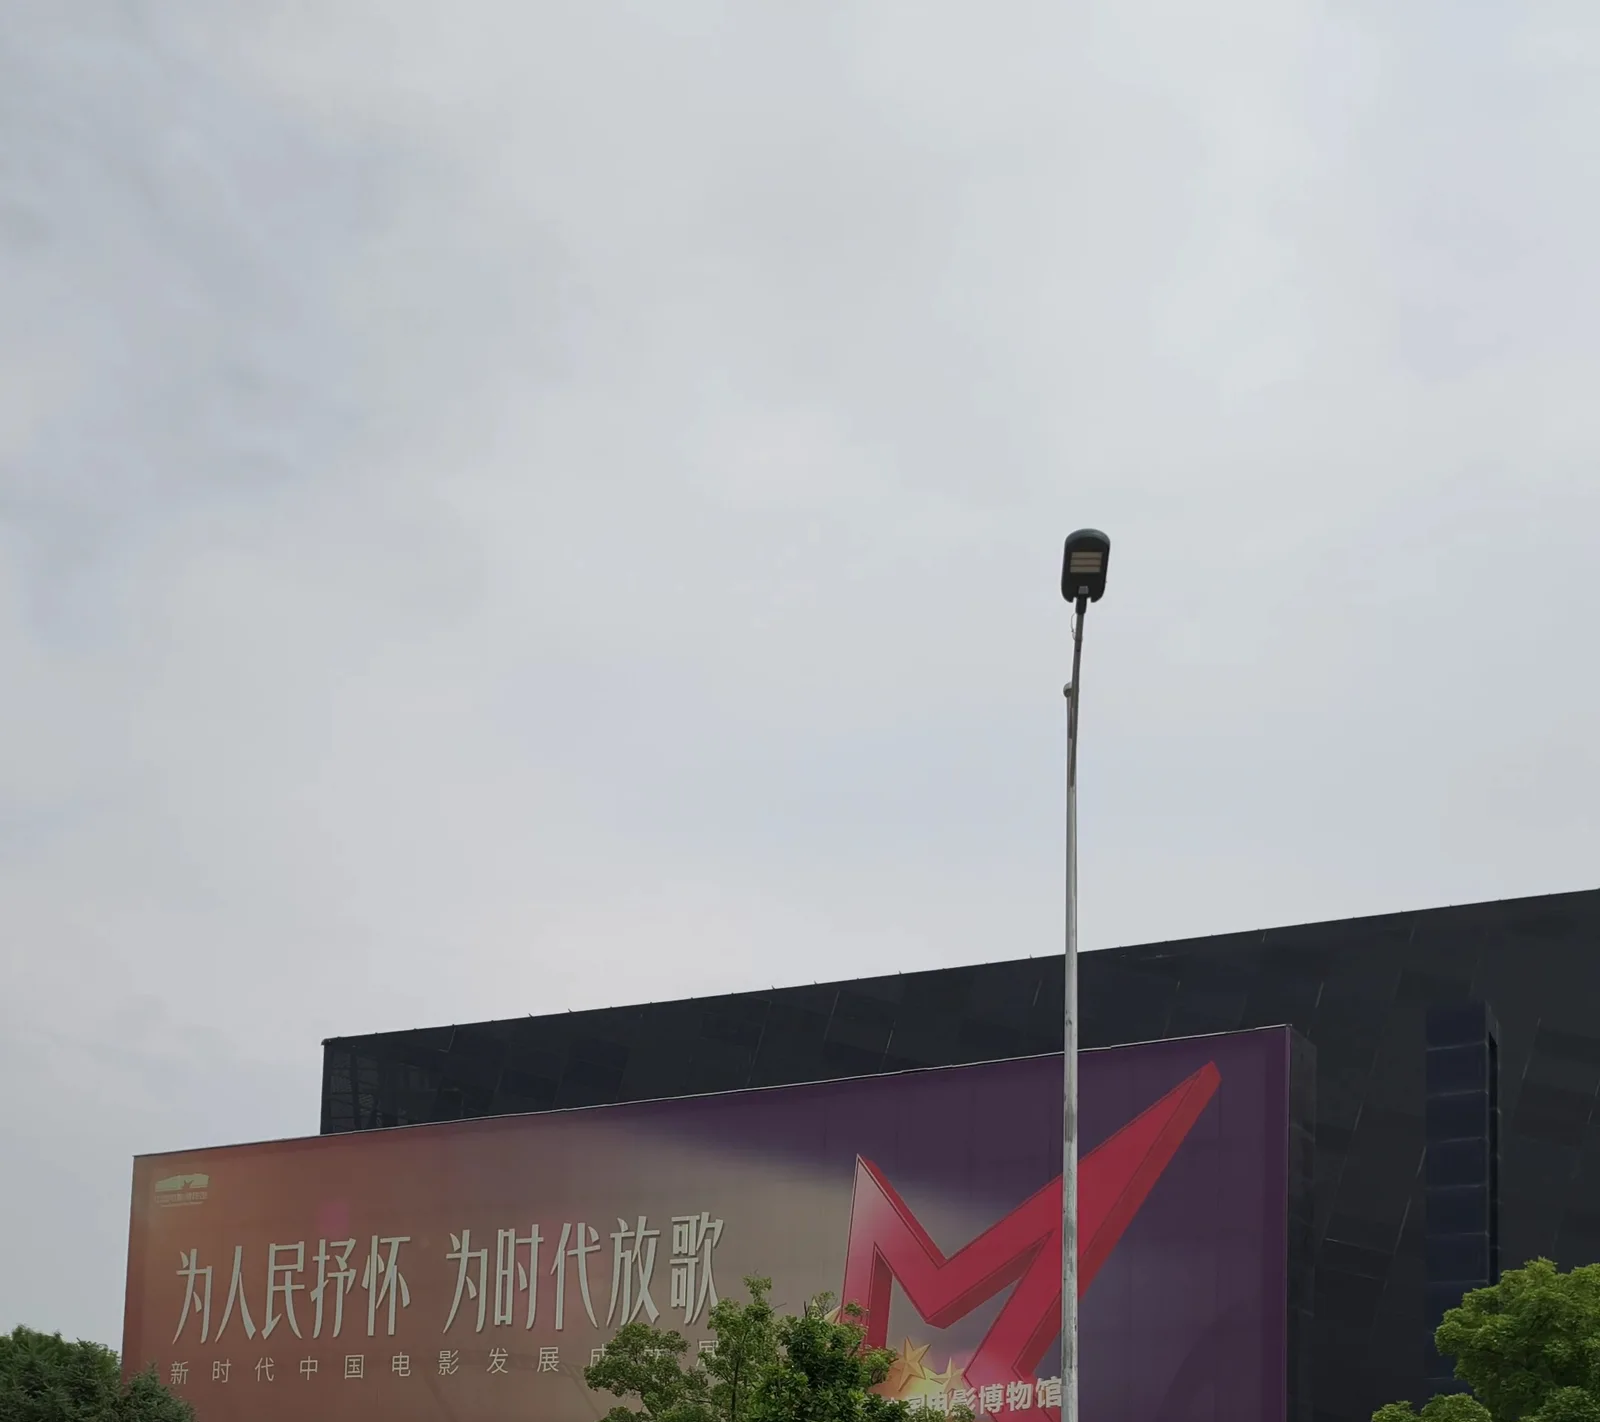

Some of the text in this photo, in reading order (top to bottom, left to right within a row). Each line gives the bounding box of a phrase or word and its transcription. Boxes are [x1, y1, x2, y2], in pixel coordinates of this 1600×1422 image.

[172, 1212, 724, 1344] 为人民抒怀 为时代放歌
